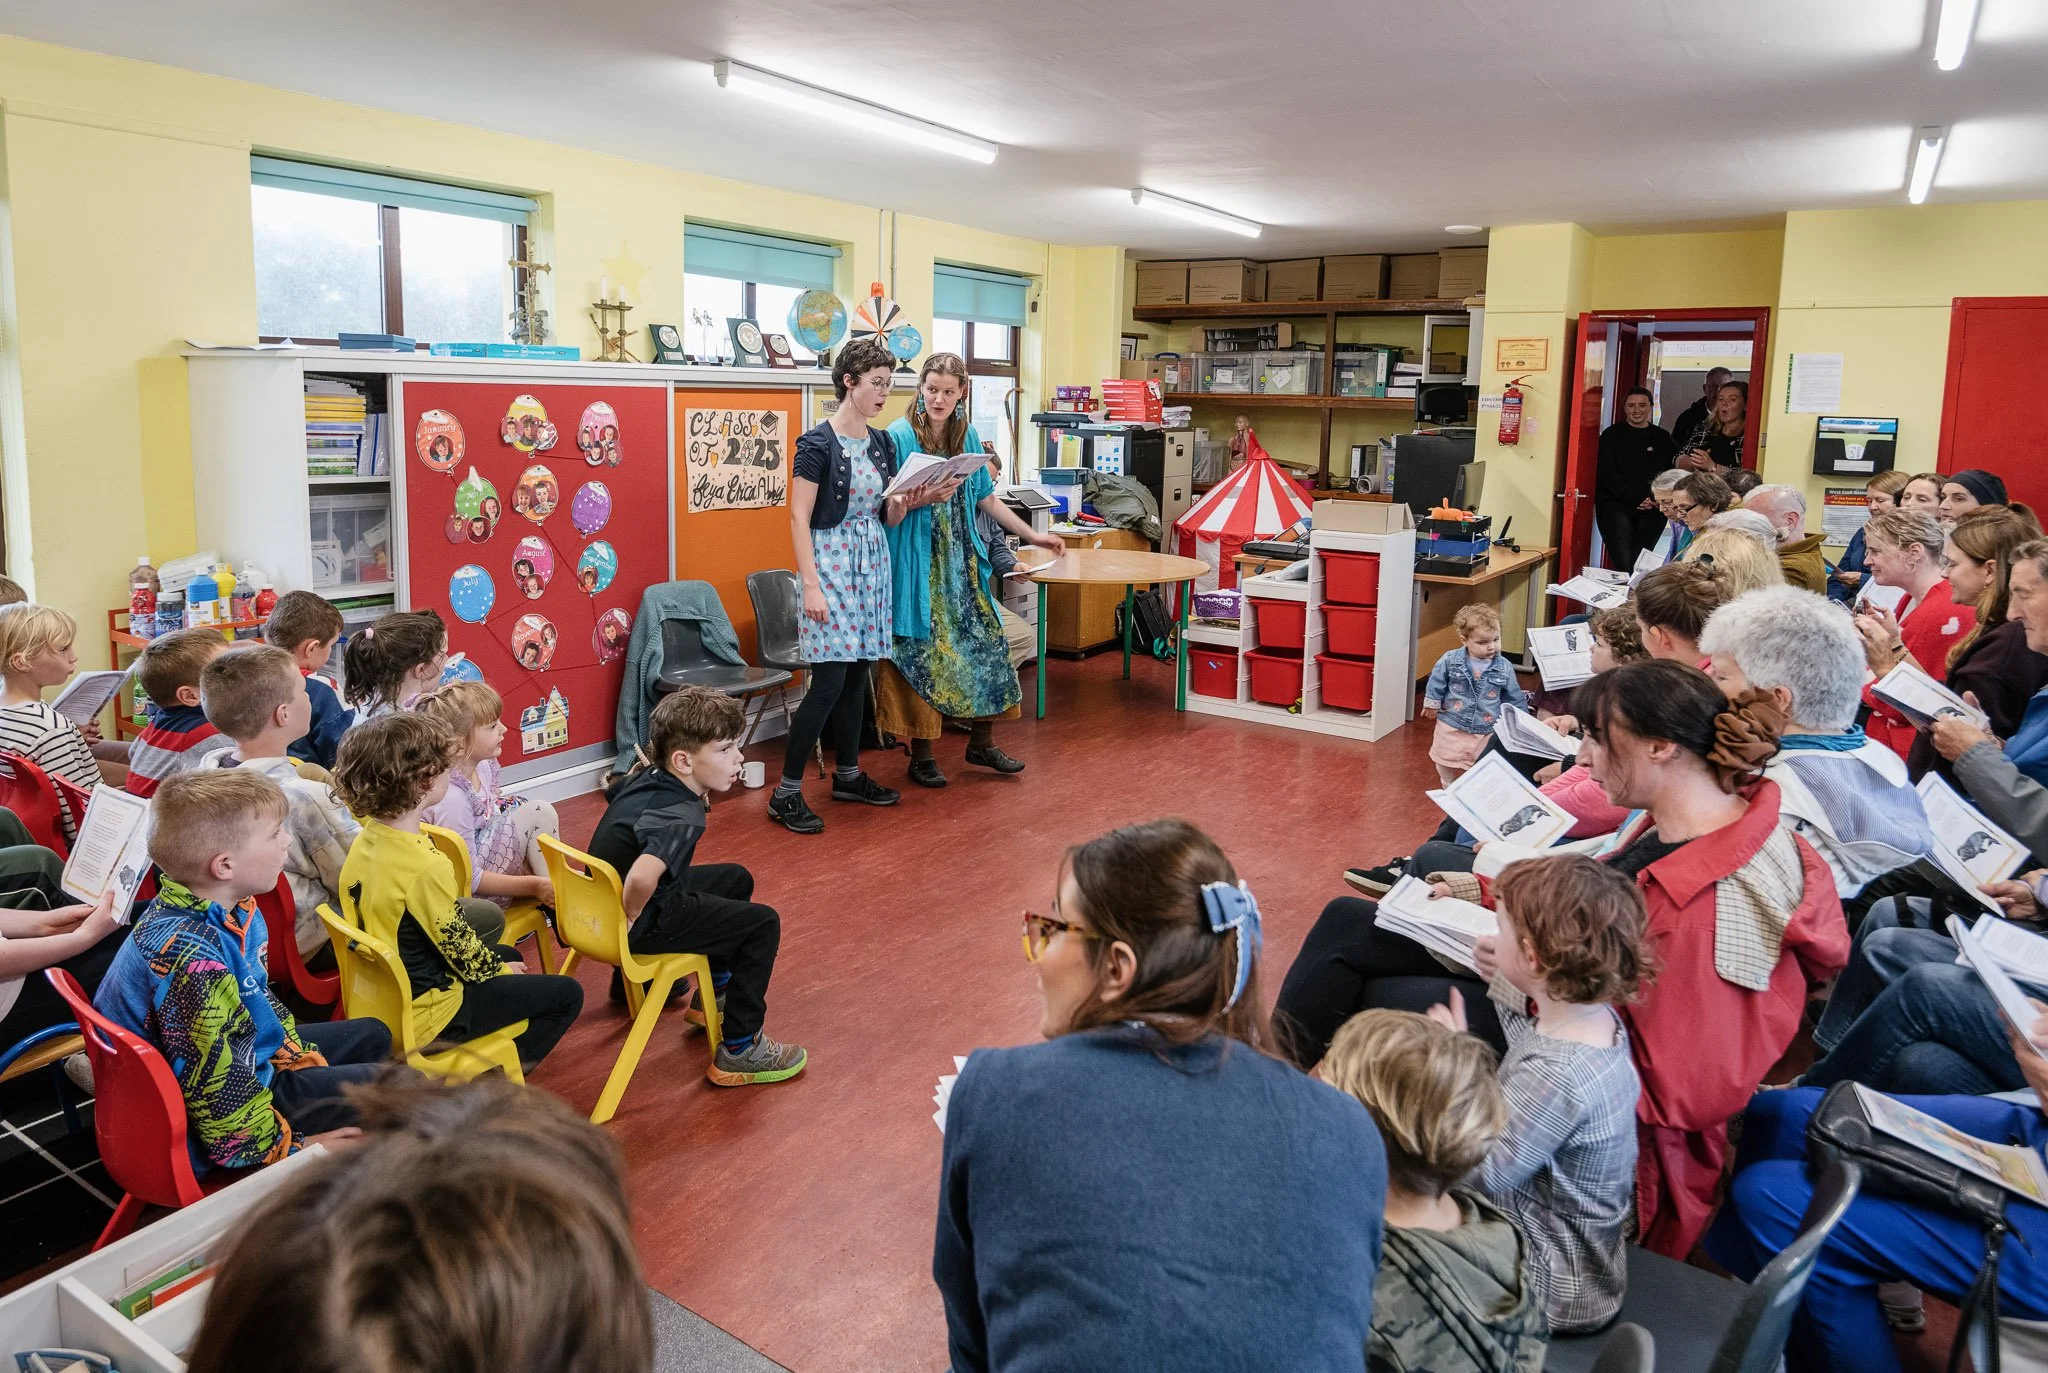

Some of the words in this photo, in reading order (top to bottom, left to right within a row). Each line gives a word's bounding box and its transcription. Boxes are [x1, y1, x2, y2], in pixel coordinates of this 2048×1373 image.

[423, 424, 456, 434] January
[690, 411, 755, 437] CLASS
[689, 439, 718, 467] OF
[723, 438, 781, 471] 2025
[588, 493, 604, 505] June
[522, 549, 547, 559] August
[583, 553, 616, 571] September
[462, 577, 479, 588] July
